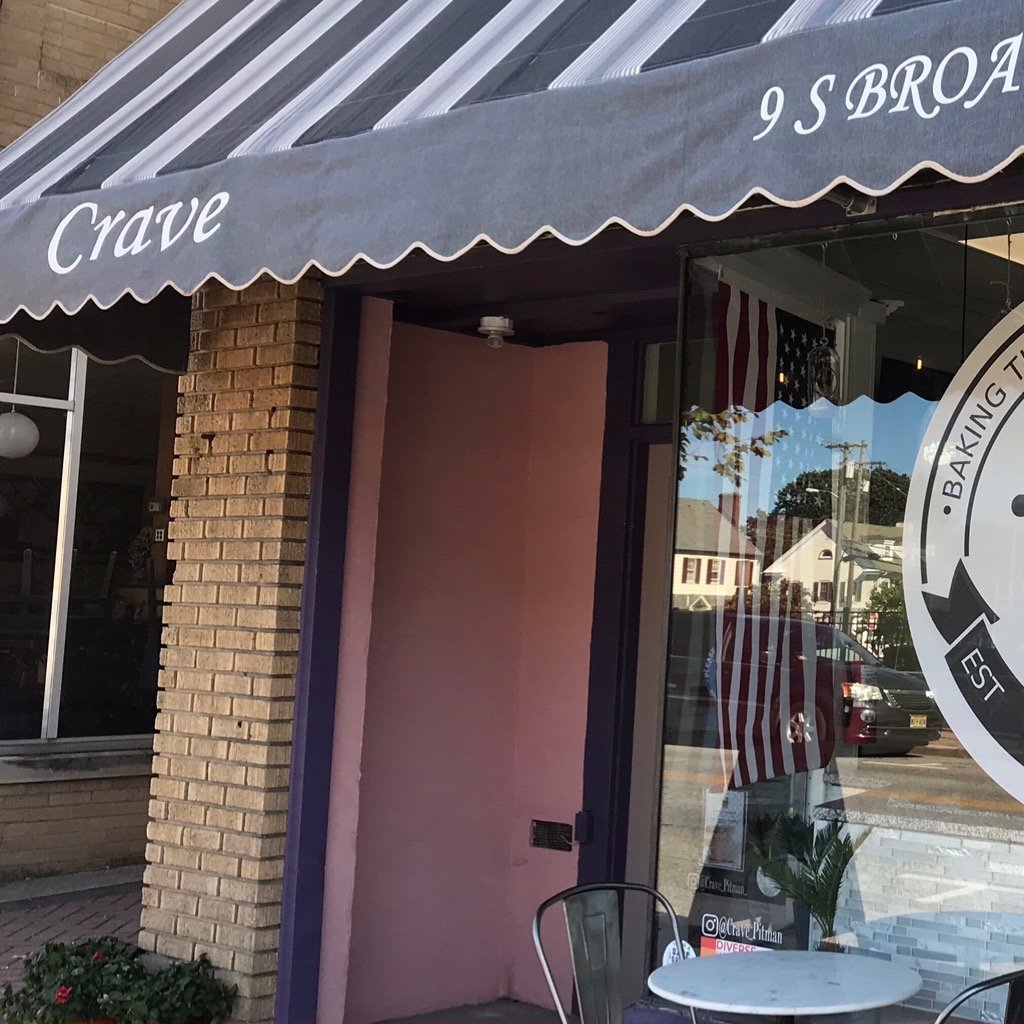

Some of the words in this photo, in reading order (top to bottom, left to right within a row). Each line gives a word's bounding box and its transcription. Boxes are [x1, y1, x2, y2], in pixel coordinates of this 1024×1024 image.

[752, 86, 785, 141] 9
[793, 73, 836, 135] S
[47, 191, 230, 275] Crave
[942, 382, 1007, 499] BAKING
[960, 648, 1005, 701] EST
